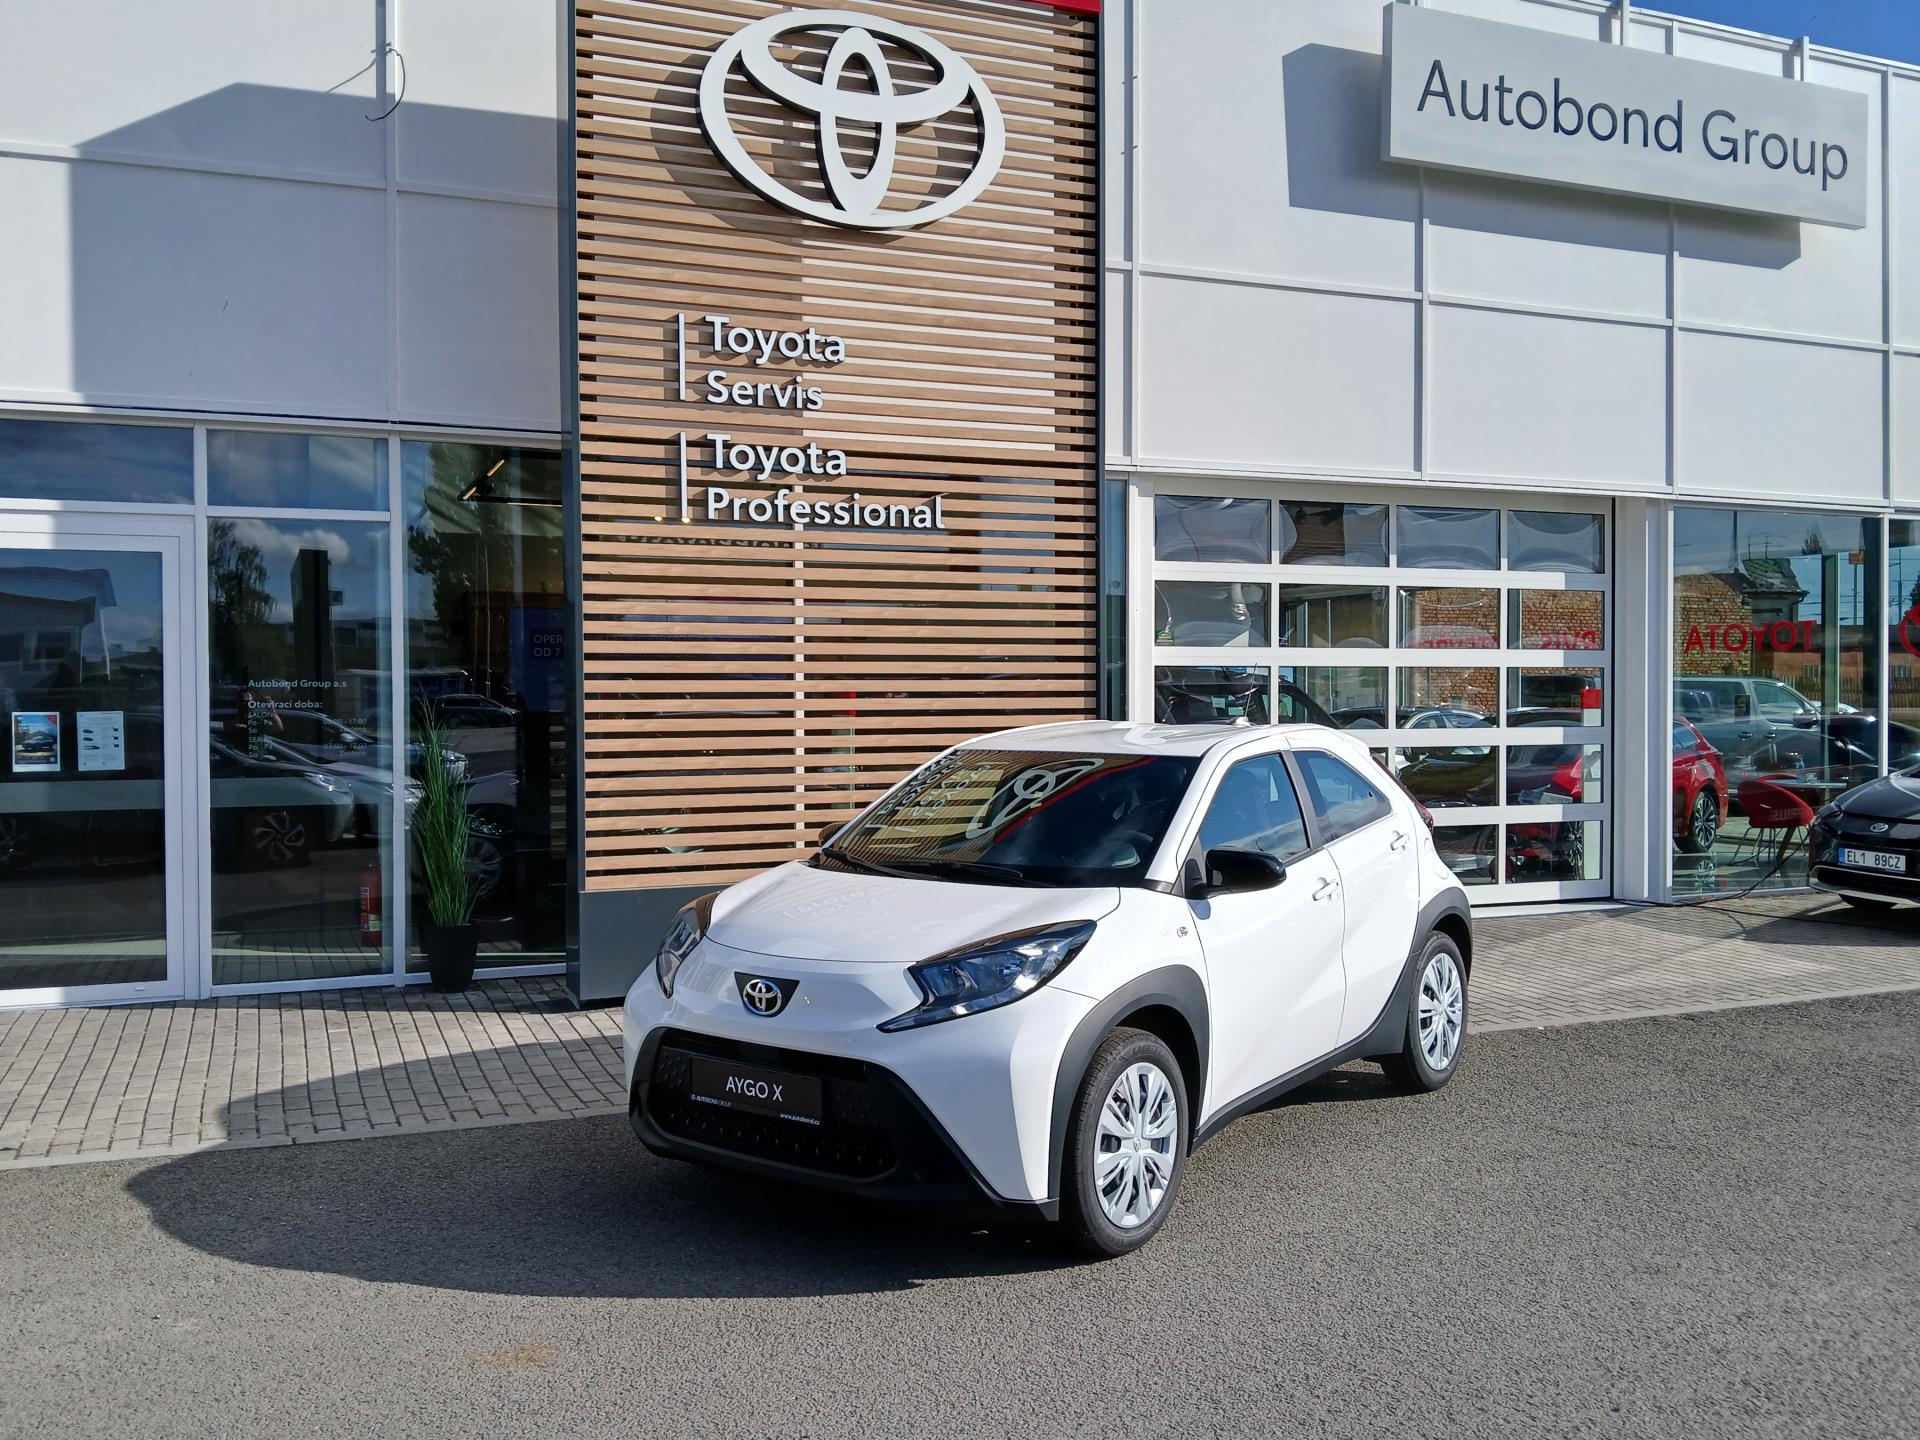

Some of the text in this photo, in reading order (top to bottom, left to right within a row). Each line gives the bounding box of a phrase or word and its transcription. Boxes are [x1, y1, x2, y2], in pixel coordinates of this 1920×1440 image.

[1417, 59, 1848, 191] Autobond Group
[705, 315, 846, 365] Toyota
[706, 370, 824, 411] Servis
[706, 433, 848, 481] Toyota
[706, 486, 946, 529] Professional
[533, 647, 561, 657] OD 7
[248, 679, 298, 688] Autobond
[300, 679, 331, 689] Group
[1847, 850, 1901, 869] EL1 89CZ
[726, 1075, 783, 1102] AYGO X
